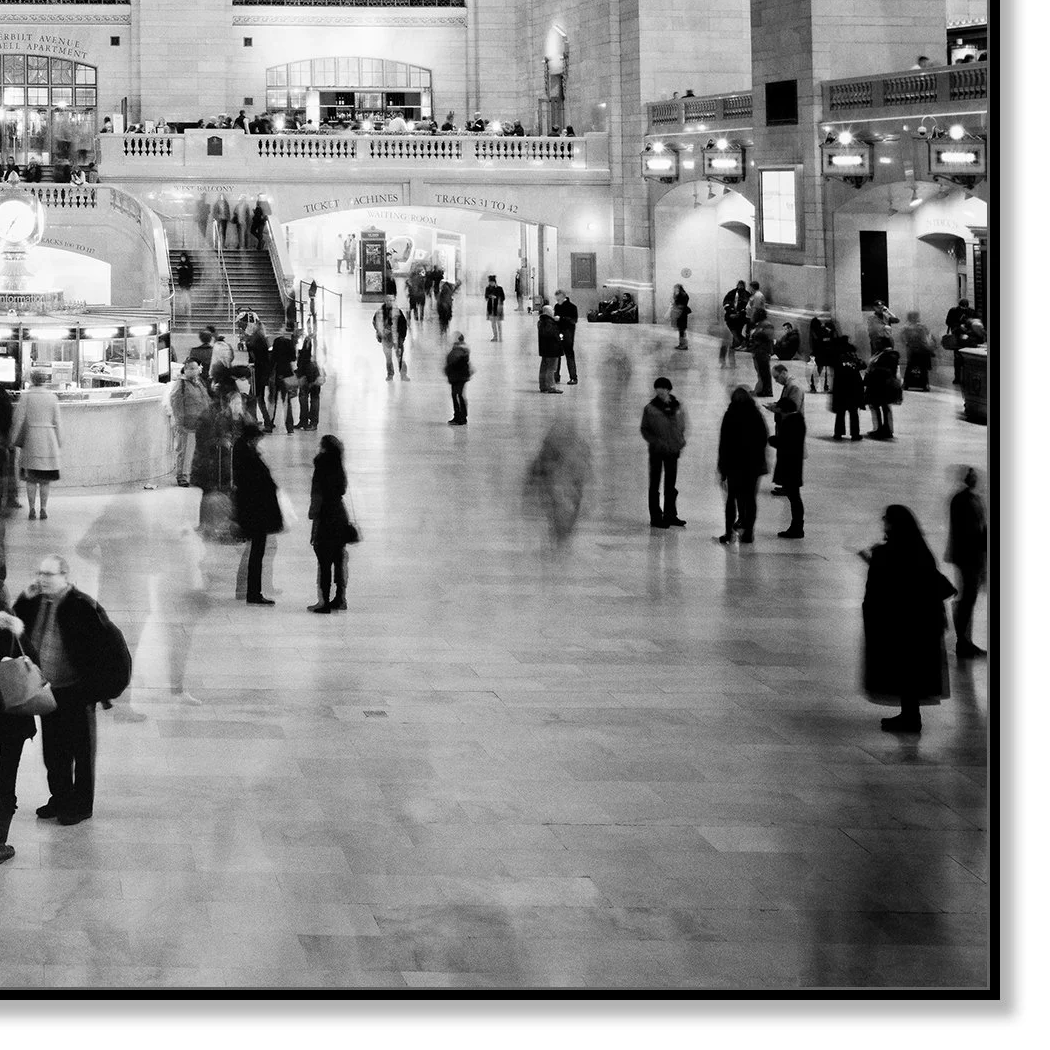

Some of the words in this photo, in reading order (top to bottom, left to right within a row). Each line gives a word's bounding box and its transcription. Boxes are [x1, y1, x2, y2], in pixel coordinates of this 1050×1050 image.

[39, 35, 81, 48] AVENUE
[26, 43, 89, 59] APARTMENT
[304, 199, 340, 213] TICKET
[353, 194, 399, 206] ACHINES
[435, 193, 477, 206] TRACKS
[478, 198, 488, 208] 31
[490, 200, 506, 211] TO
[507, 204, 519, 214] 42
[368, 210, 407, 220] WAITING
[411, 214, 438, 225] ROOM
